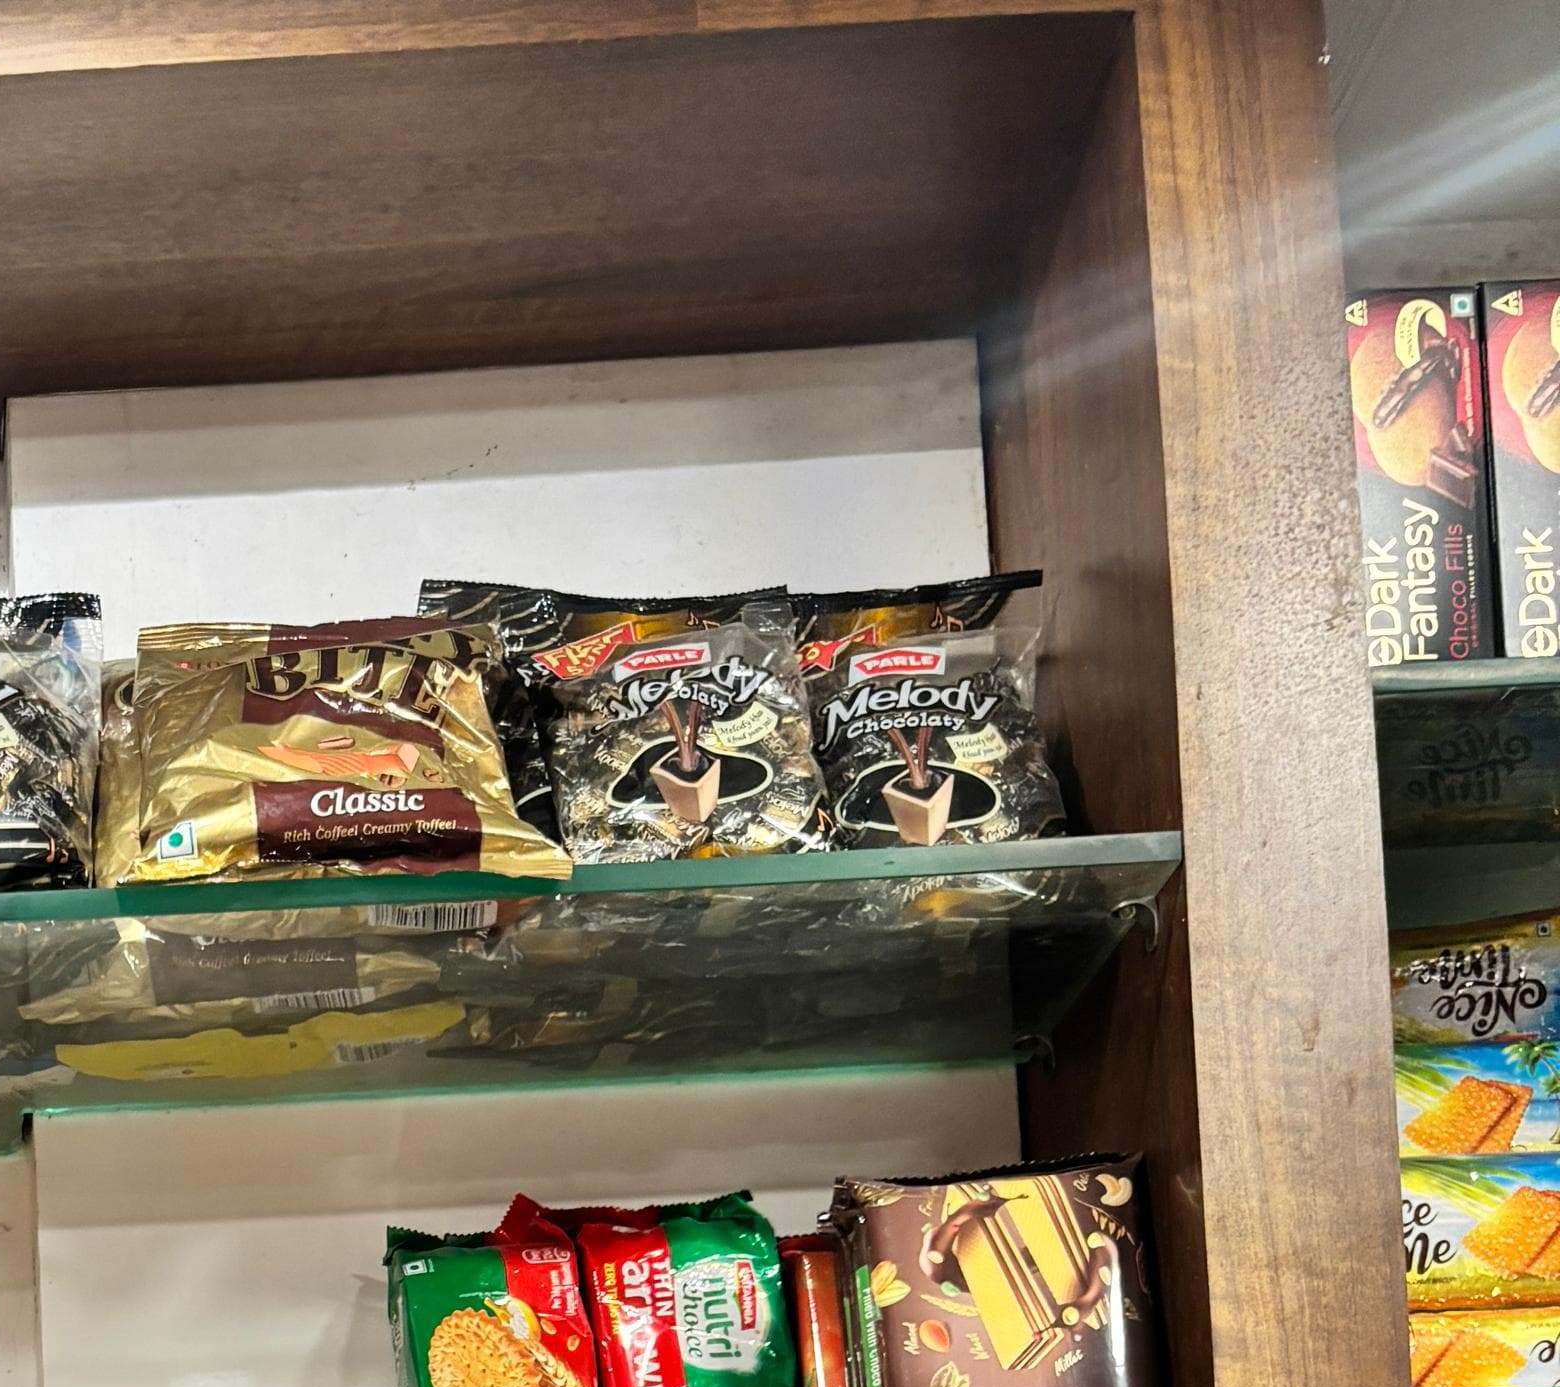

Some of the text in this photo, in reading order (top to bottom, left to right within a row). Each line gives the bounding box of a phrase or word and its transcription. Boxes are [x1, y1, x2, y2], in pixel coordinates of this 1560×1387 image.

[1362, 535, 1402, 637] Dark
[1402, 497, 1440, 661] Fantasy
[1444, 523, 1470, 661] Choco Fills
[1515, 527, 1554, 627] Dark
[627, 648, 700, 668] PARLE
[864, 655, 934, 671] PARLE
[819, 680, 998, 750] Melody
[847, 711, 966, 739] Chocolaty
[310, 789, 425, 818] Classic
[283, 829, 311, 844] Rich
[362, 821, 412, 837] Creamy
